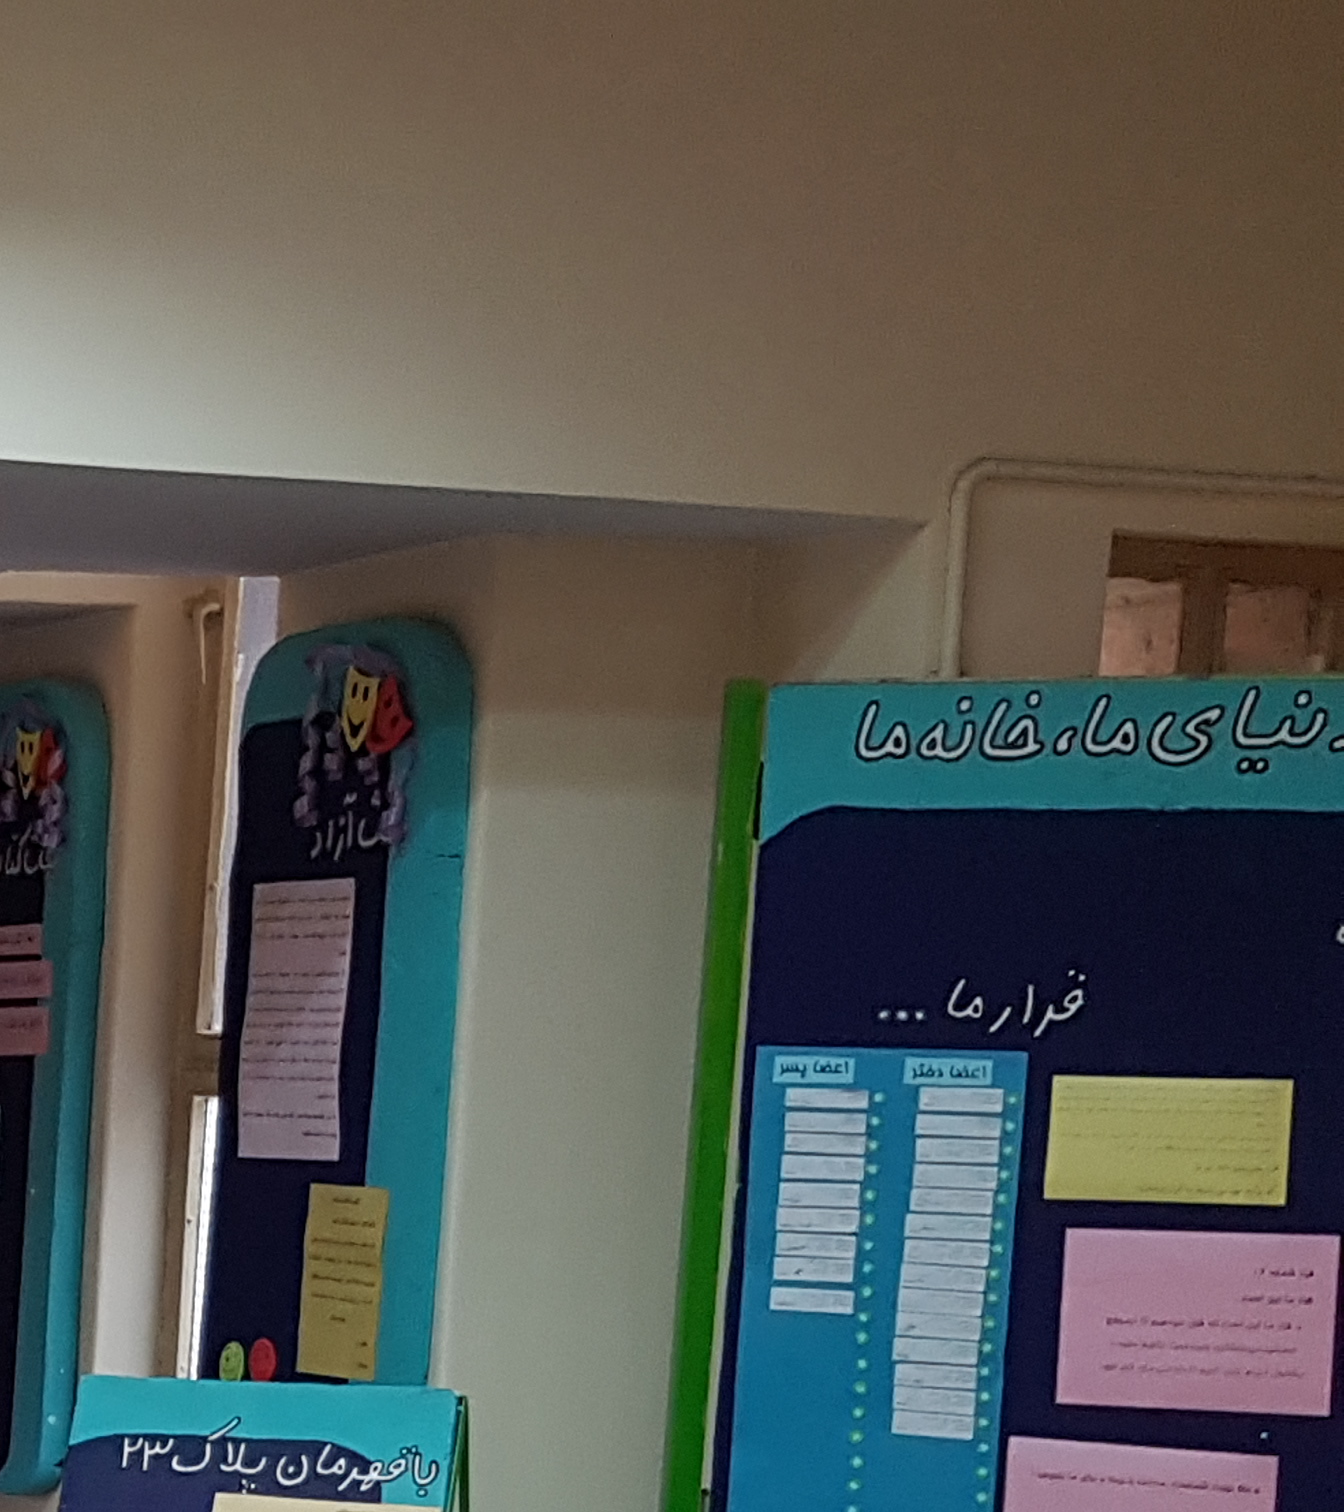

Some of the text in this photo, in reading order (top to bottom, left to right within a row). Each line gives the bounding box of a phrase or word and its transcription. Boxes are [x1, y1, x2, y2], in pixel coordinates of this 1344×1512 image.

[854, 699, 912, 763] ما
[916, 690, 1044, 762] خانه
[1149, 686, 1344, 774] نیای
[946, 978, 984, 1019] ما
[988, 969, 1088, 1038] قرار
[778, 1060, 808, 1079] پسر
[912, 1062, 944, 1080] دختر
[170, 1416, 269, 1494] پلاک
[275, 1442, 418, 1492] قهرمان
